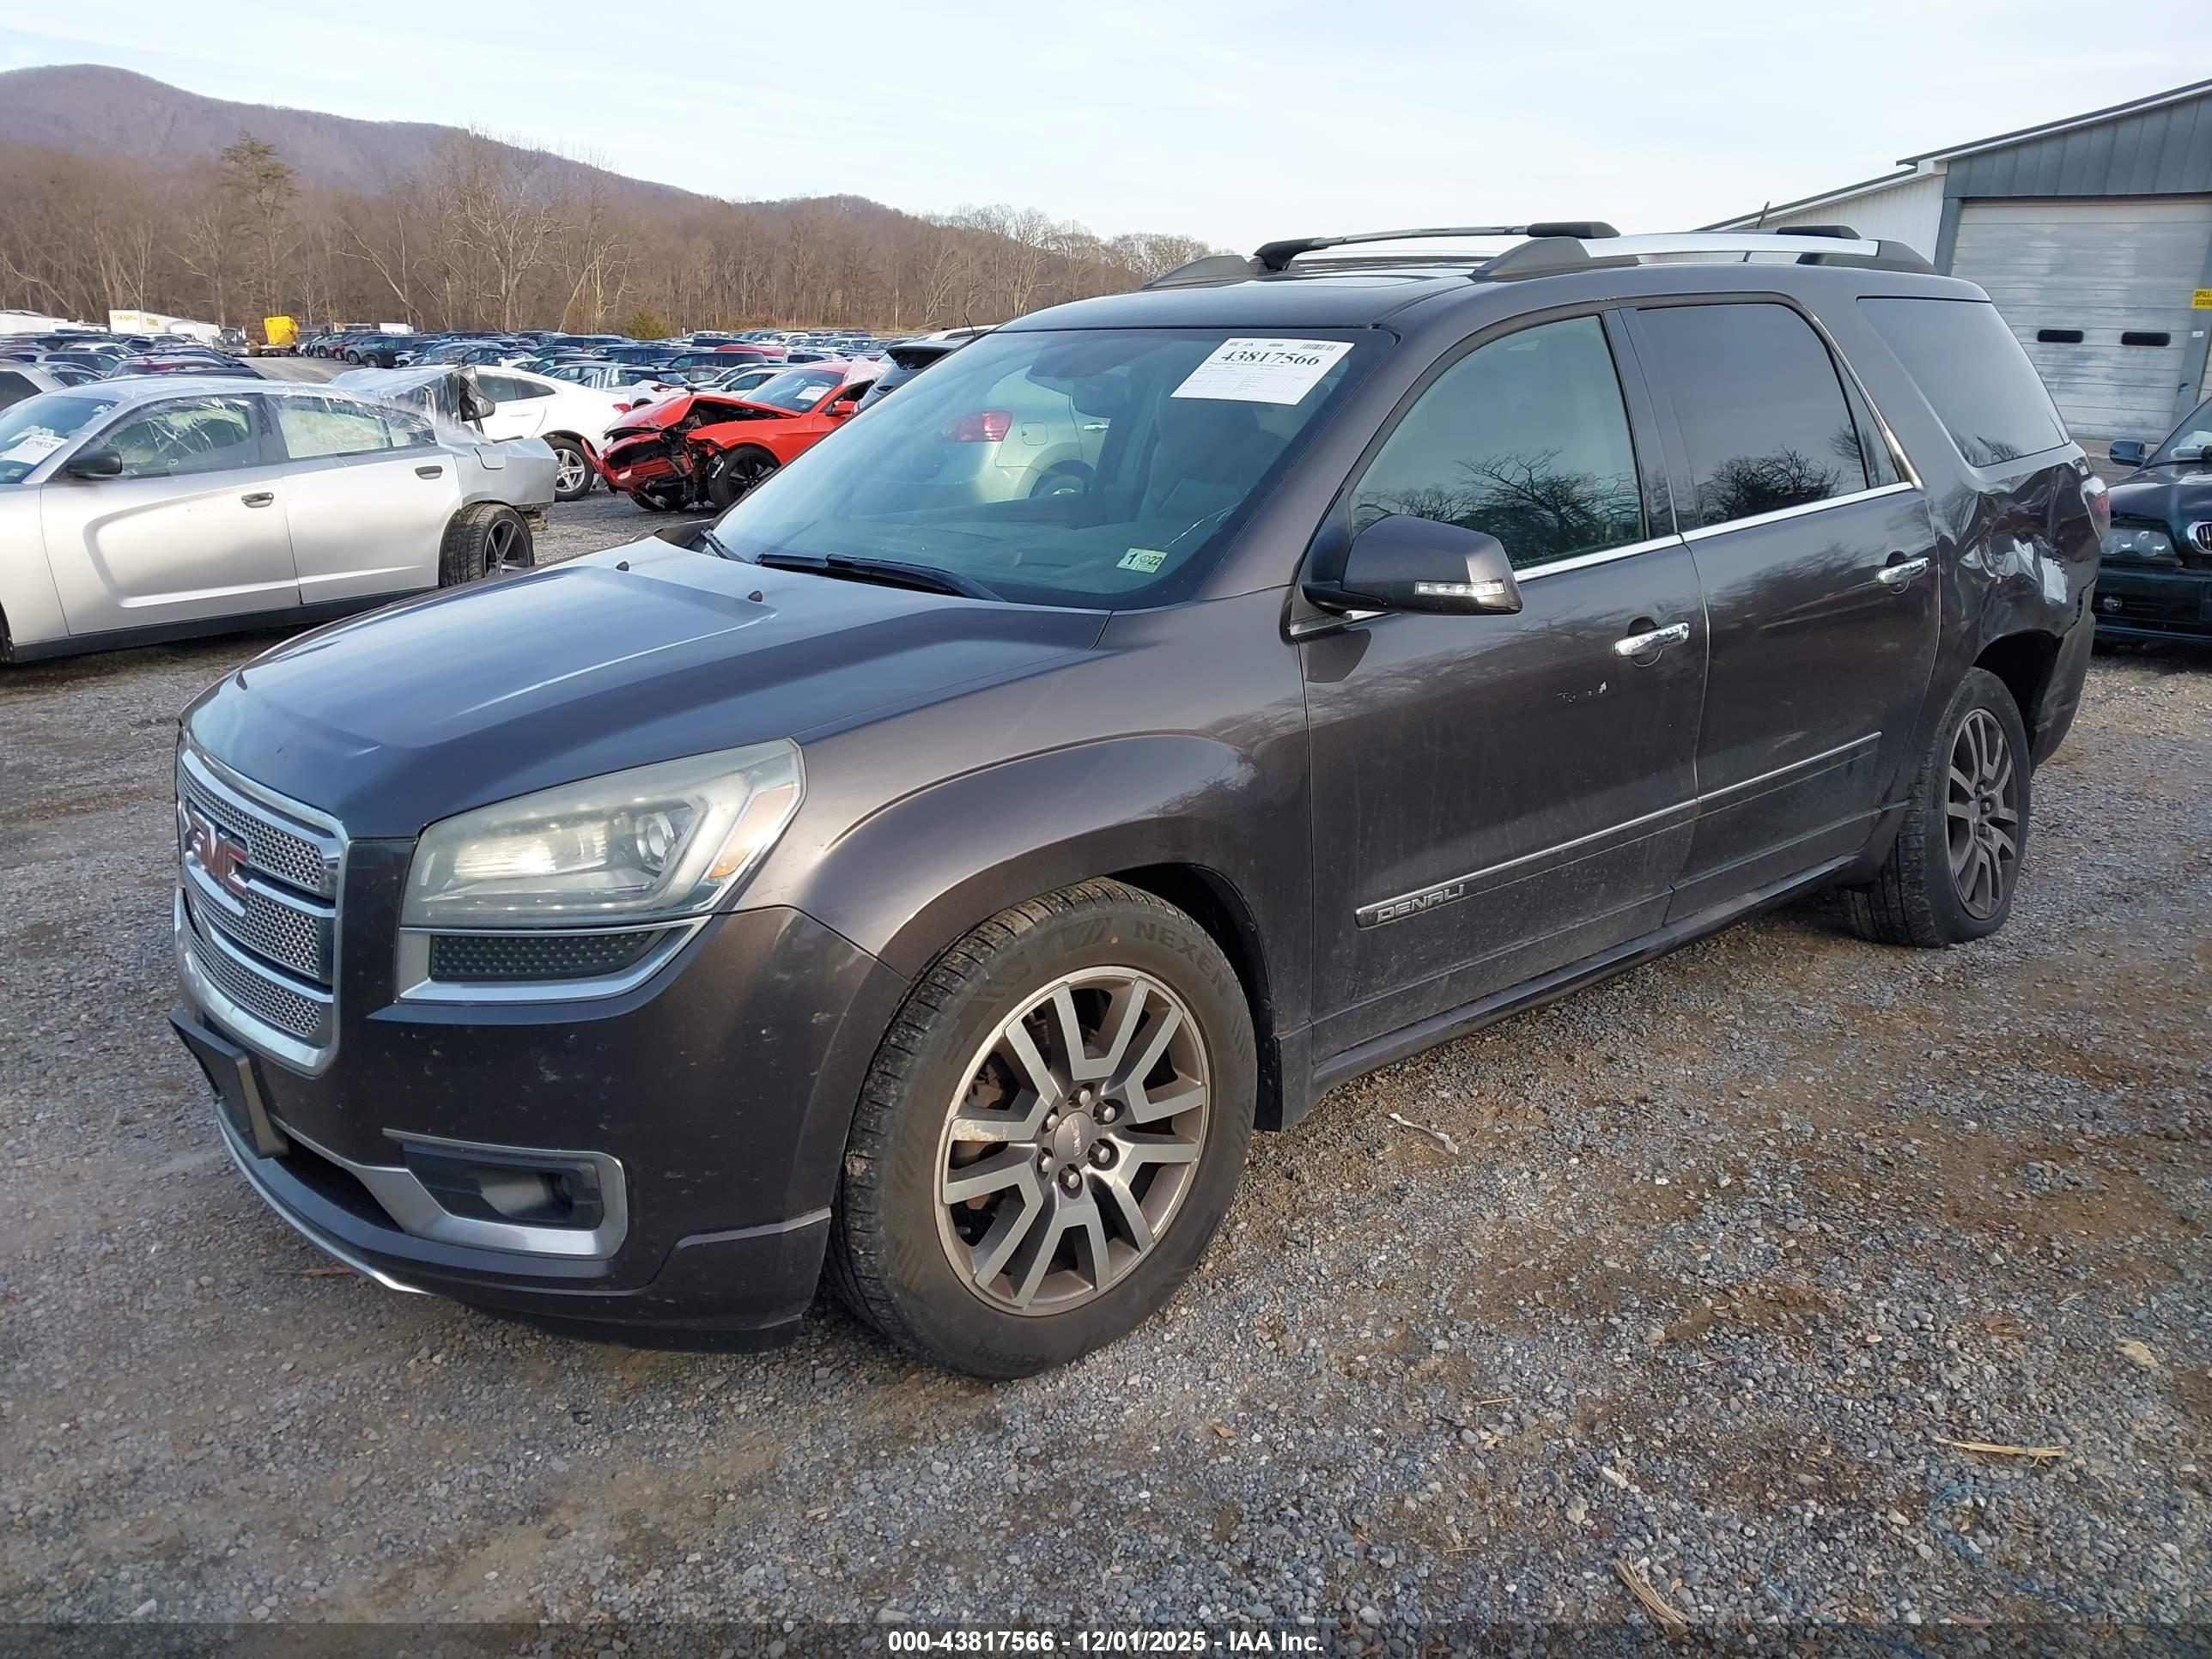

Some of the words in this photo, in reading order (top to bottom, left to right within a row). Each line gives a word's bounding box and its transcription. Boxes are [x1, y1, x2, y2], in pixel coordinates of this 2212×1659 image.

[1222, 350, 1324, 366] 43817566
[1127, 552, 1139, 565] 1
[1147, 556, 1163, 565] 22
[183, 809, 247, 899] GMC
[1376, 884, 1466, 922] DENALI
[1133, 920, 1228, 996] NEXEN
